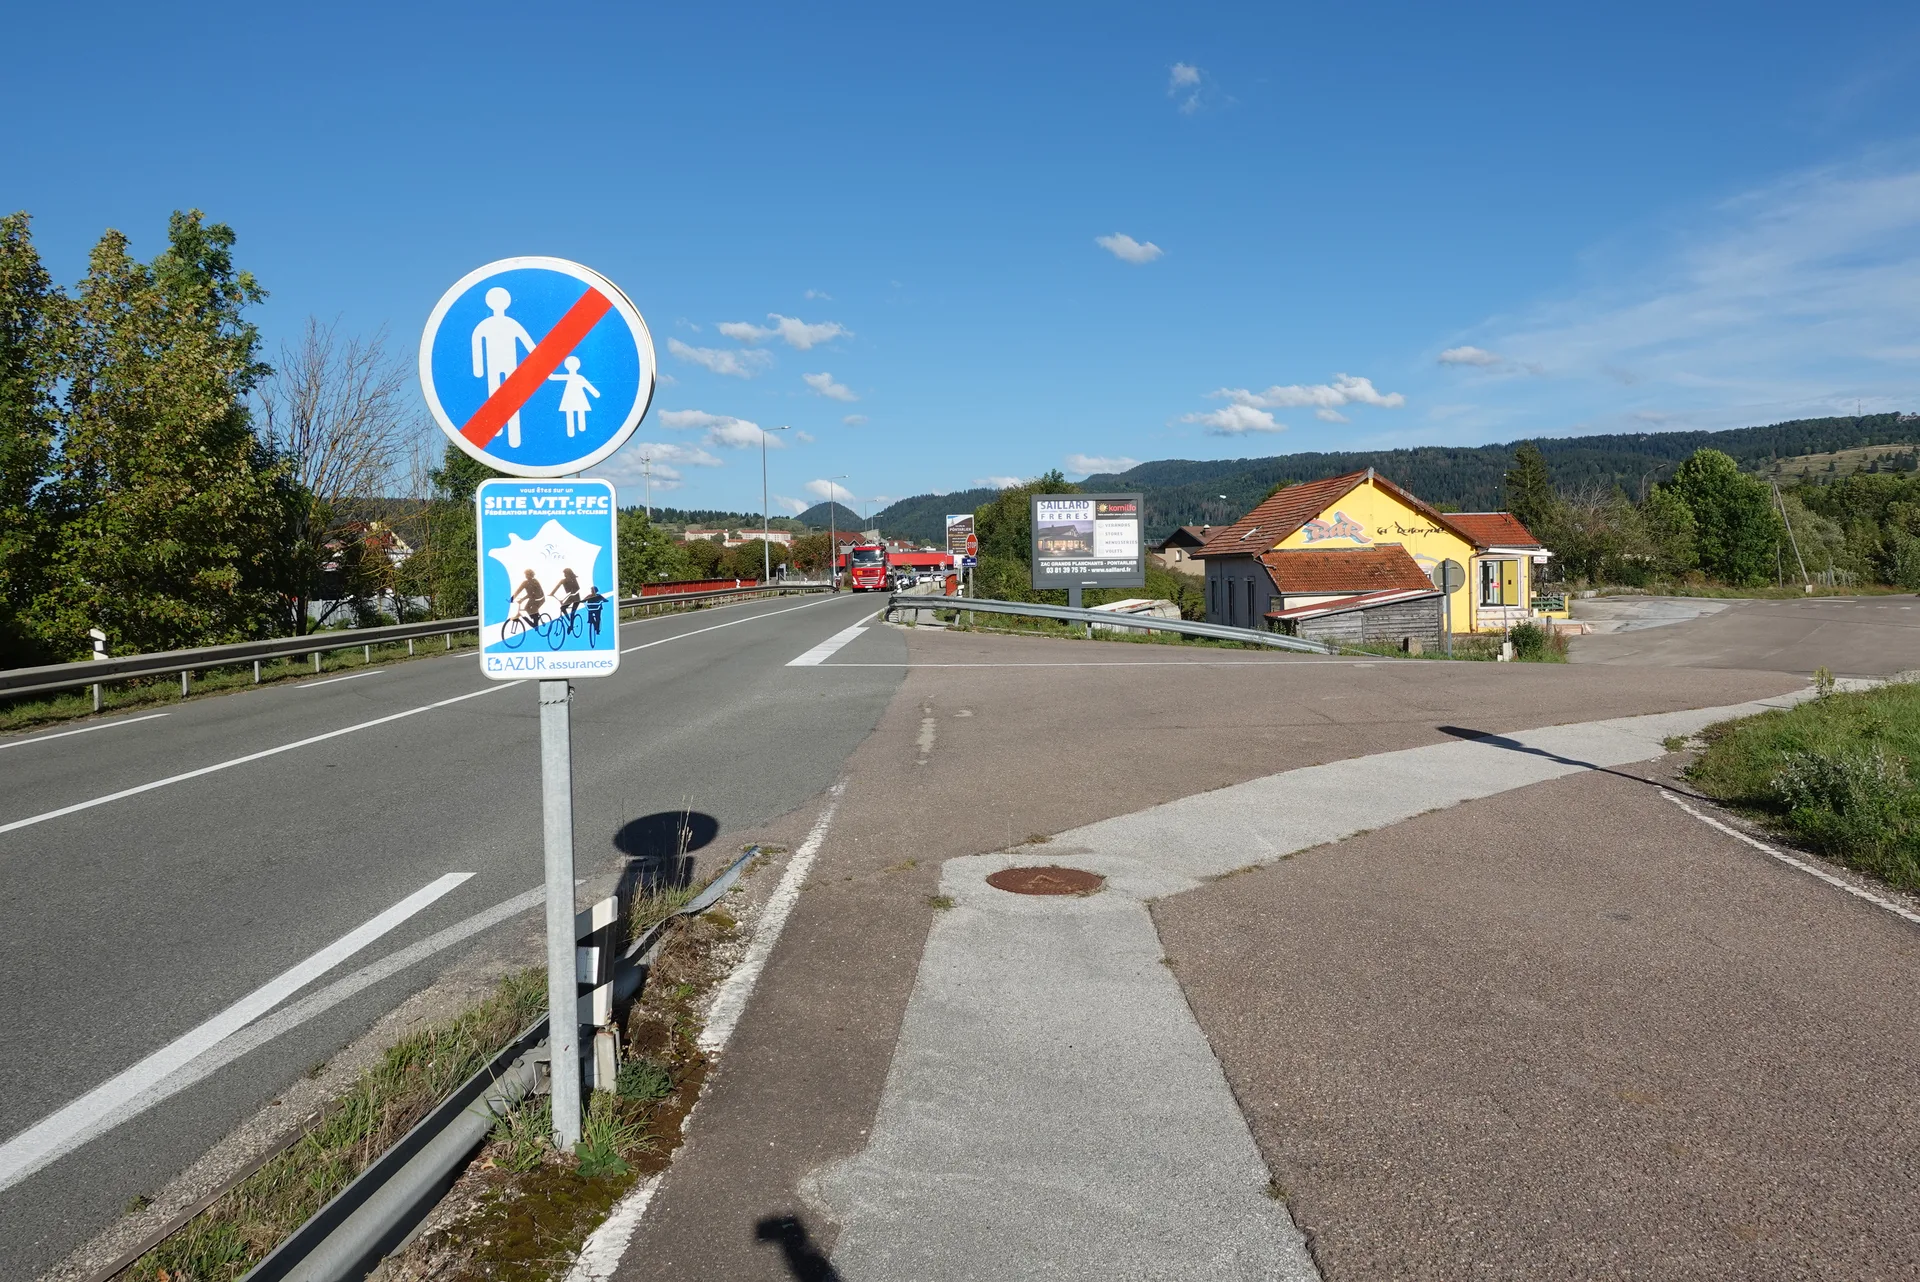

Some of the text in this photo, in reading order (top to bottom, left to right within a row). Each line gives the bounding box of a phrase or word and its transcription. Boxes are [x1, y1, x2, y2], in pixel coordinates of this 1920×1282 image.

[485, 496, 608, 508] SITE VTT-FFC
[1040, 500, 1090, 510] SAILLARD
[1108, 504, 1137, 512] komilfo
[504, 656, 614, 671] AZUR assurances
